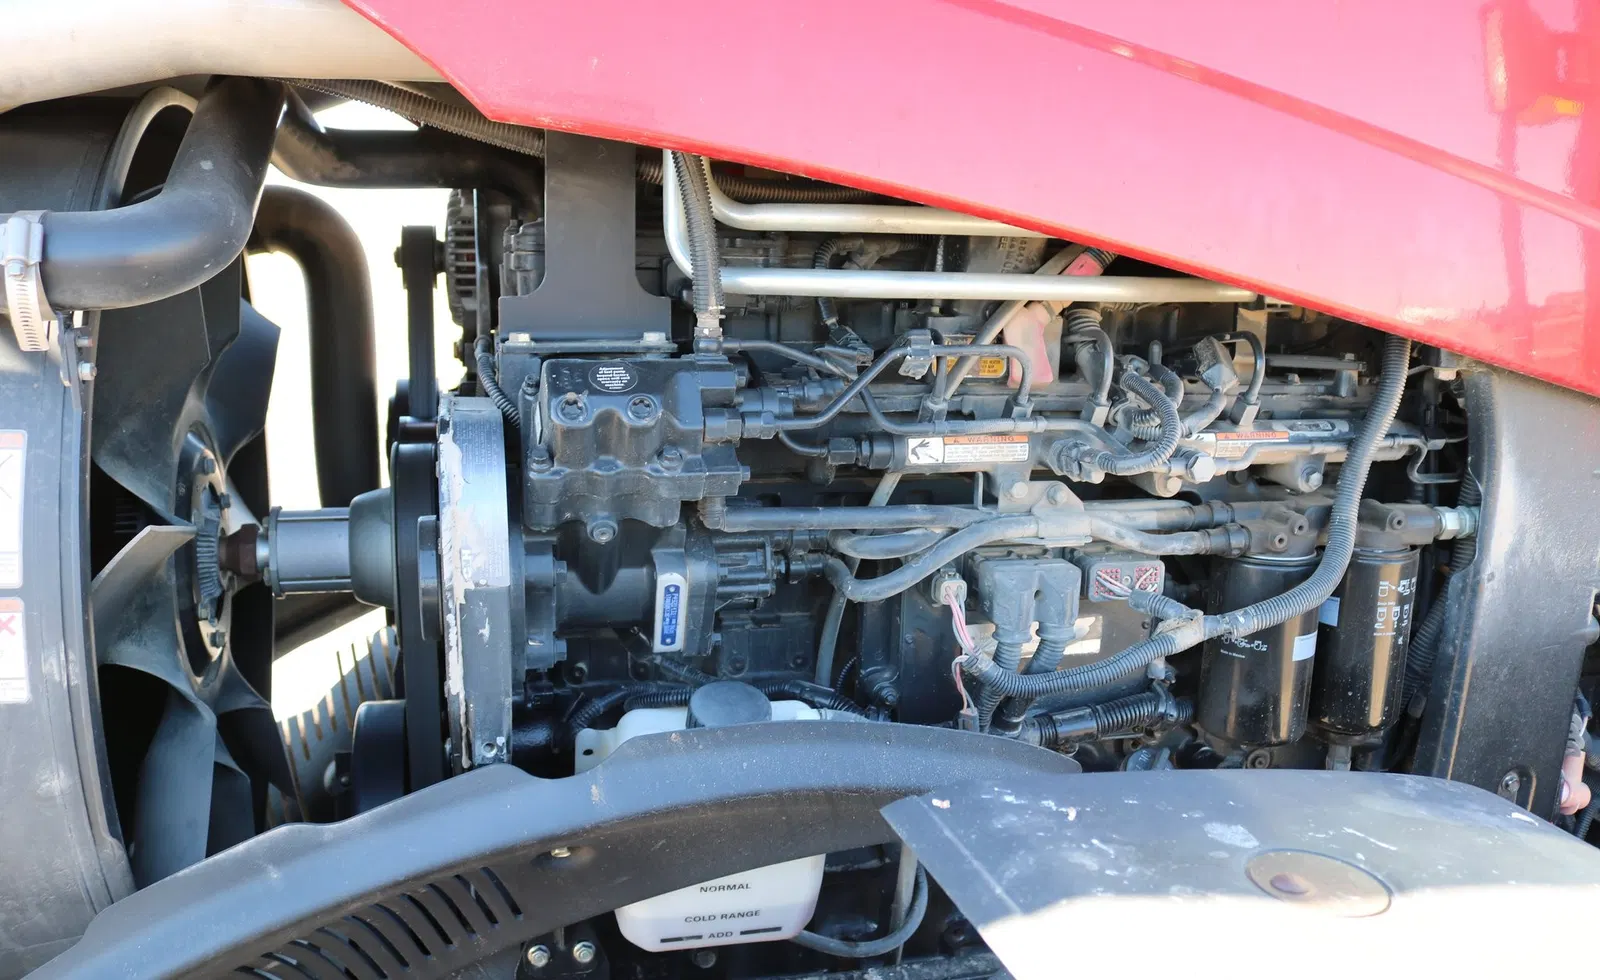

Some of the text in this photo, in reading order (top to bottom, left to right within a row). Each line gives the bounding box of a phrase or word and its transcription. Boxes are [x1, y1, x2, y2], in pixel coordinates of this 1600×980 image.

[700, 883, 752, 893] NORMAL
[684, 910, 761, 923] COLD RANGE
[708, 931, 734, 939] ADD
